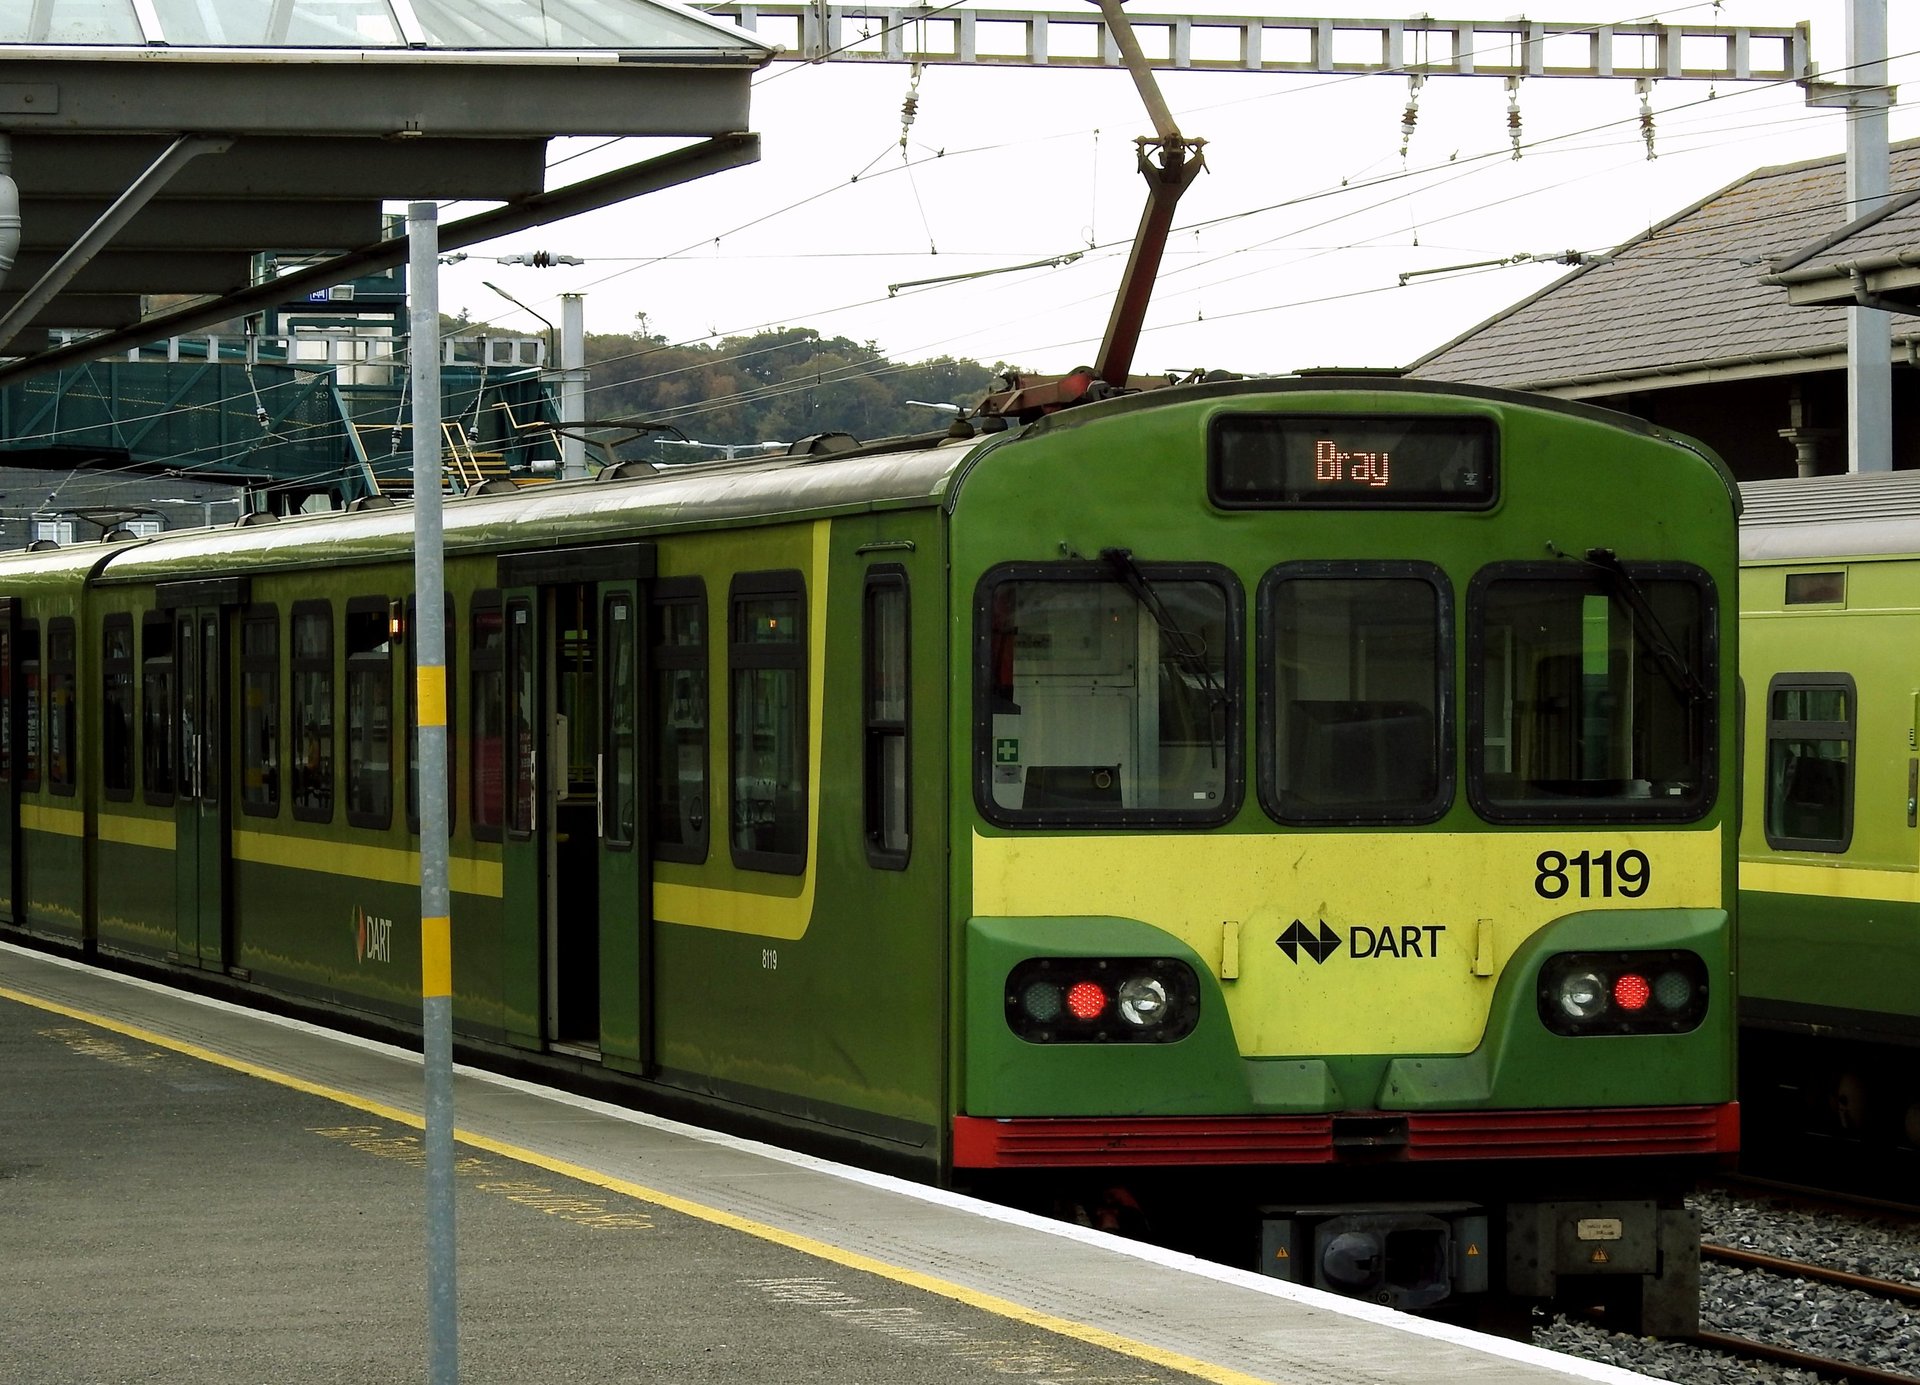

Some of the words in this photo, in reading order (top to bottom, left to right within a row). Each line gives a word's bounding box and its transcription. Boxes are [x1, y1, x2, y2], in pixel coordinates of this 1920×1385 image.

[1317, 441, 1388, 486] Bray
[1535, 849, 1650, 899] 8119
[367, 915, 392, 963] DART
[762, 948, 778, 970] 8119
[1350, 926, 1446, 958] DART
